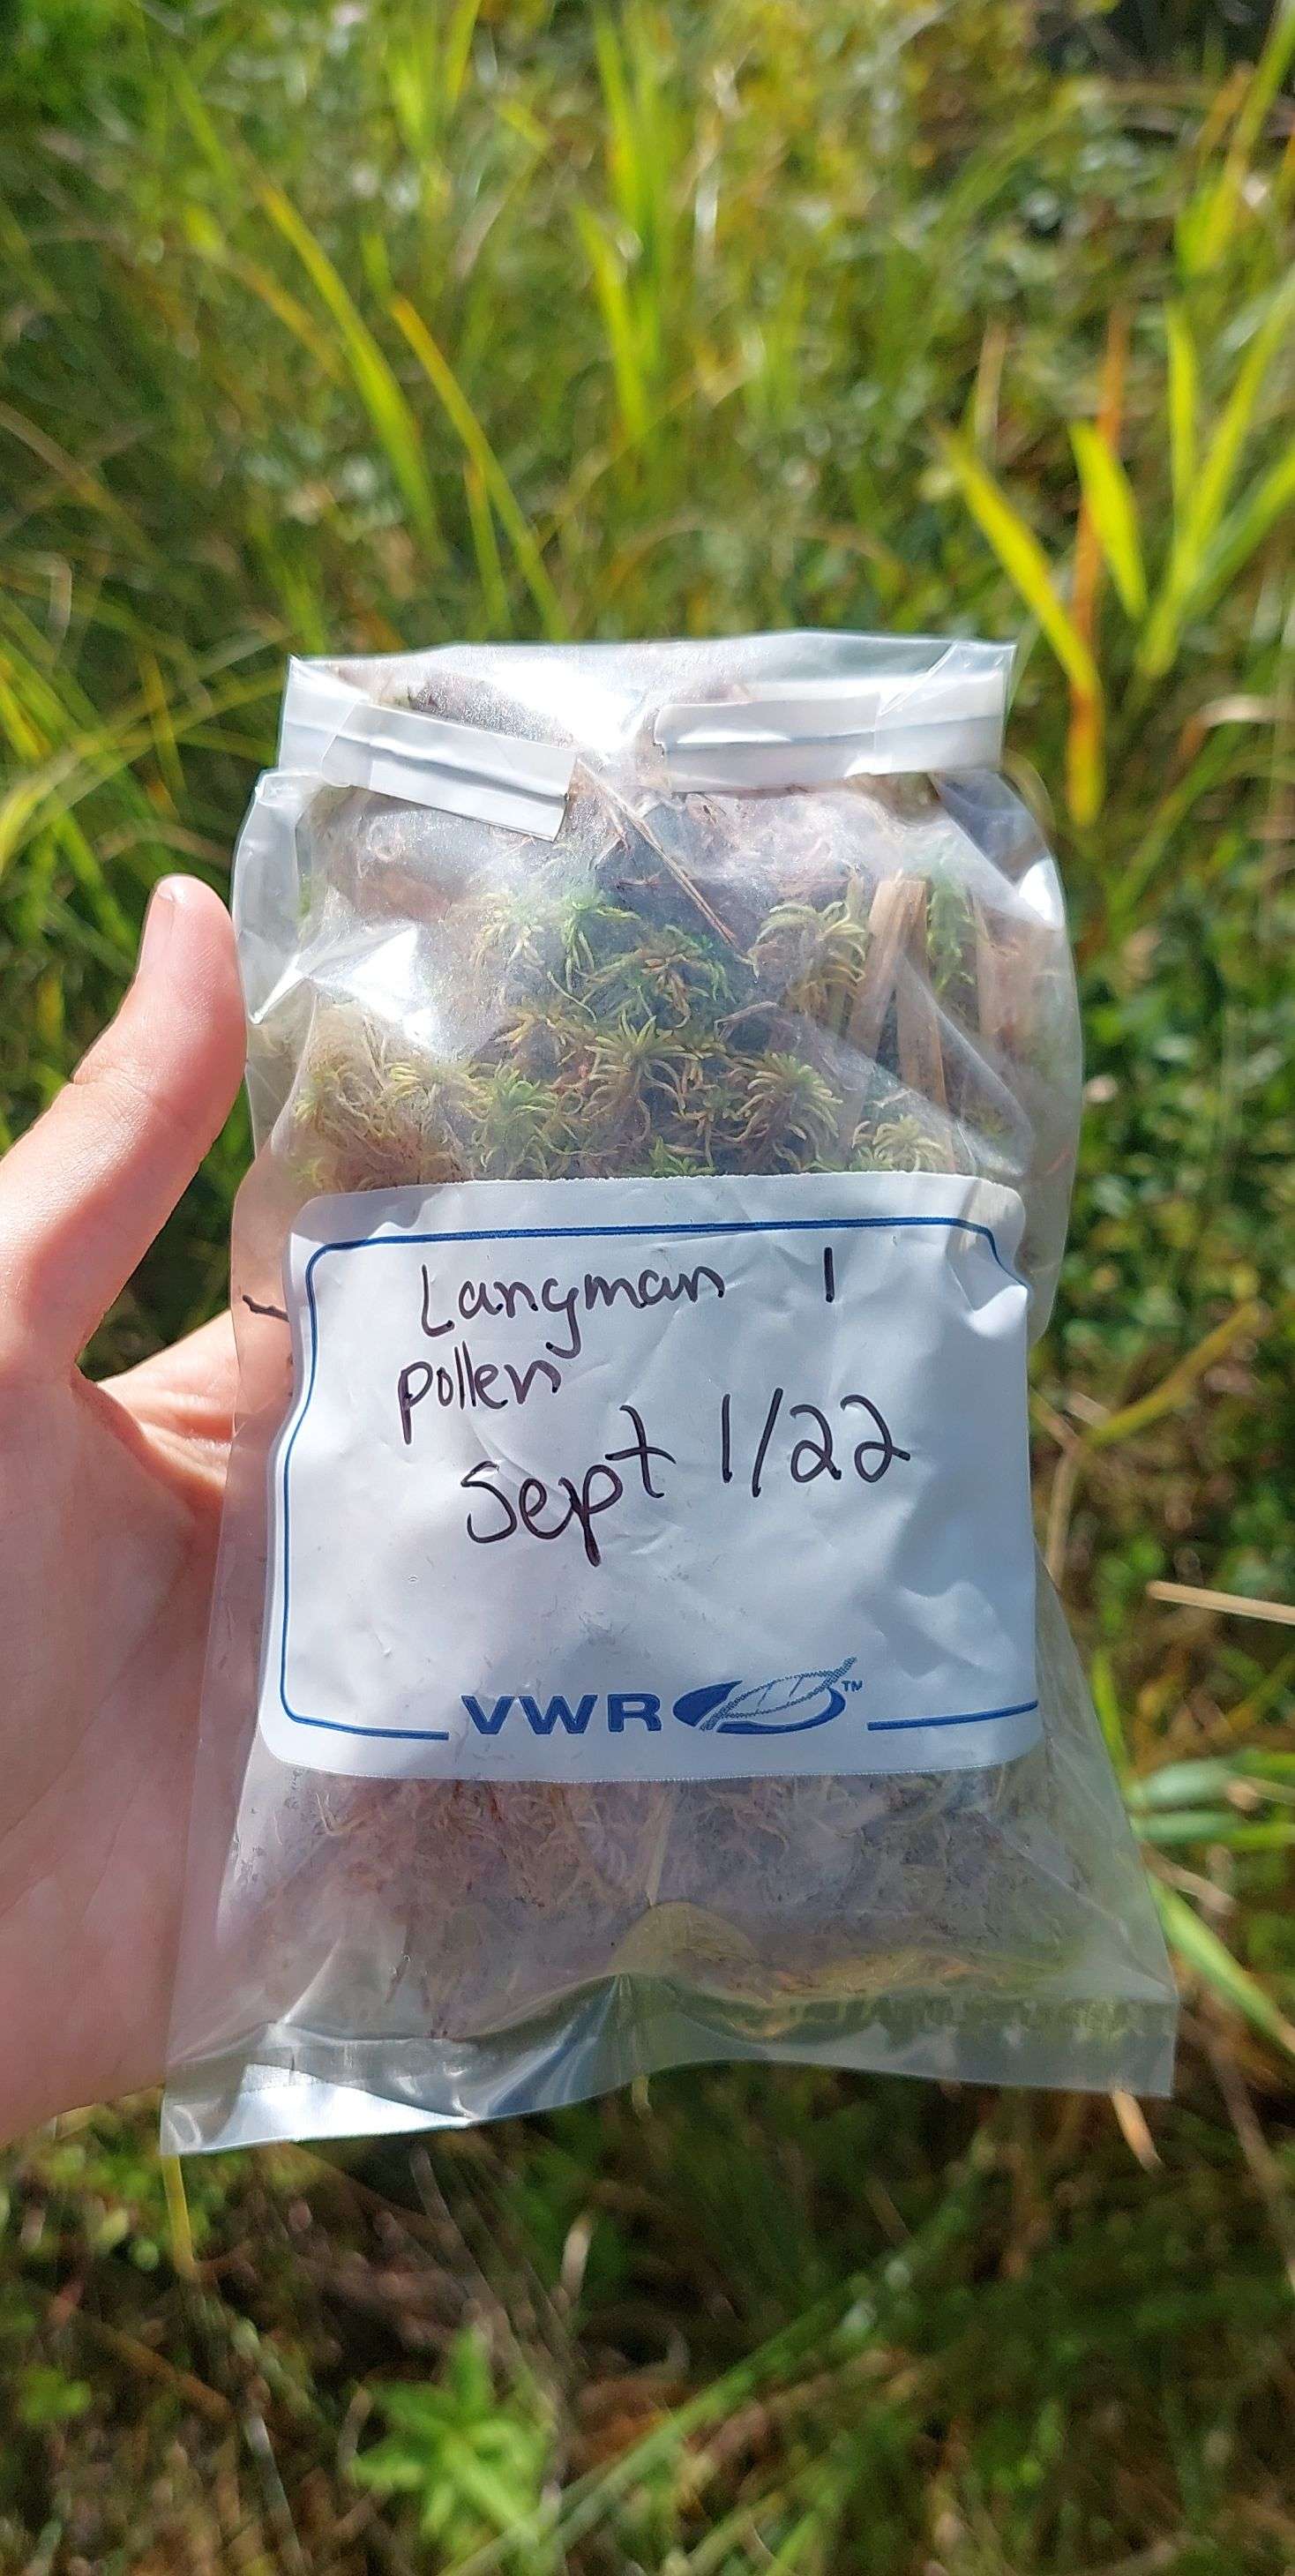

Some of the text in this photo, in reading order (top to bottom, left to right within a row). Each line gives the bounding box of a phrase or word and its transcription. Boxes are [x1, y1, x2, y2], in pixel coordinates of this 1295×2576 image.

[421, 1263, 725, 1359] Langman
[721, 1387, 910, 1498] 1/22
[460, 1693, 662, 1735] VWR
